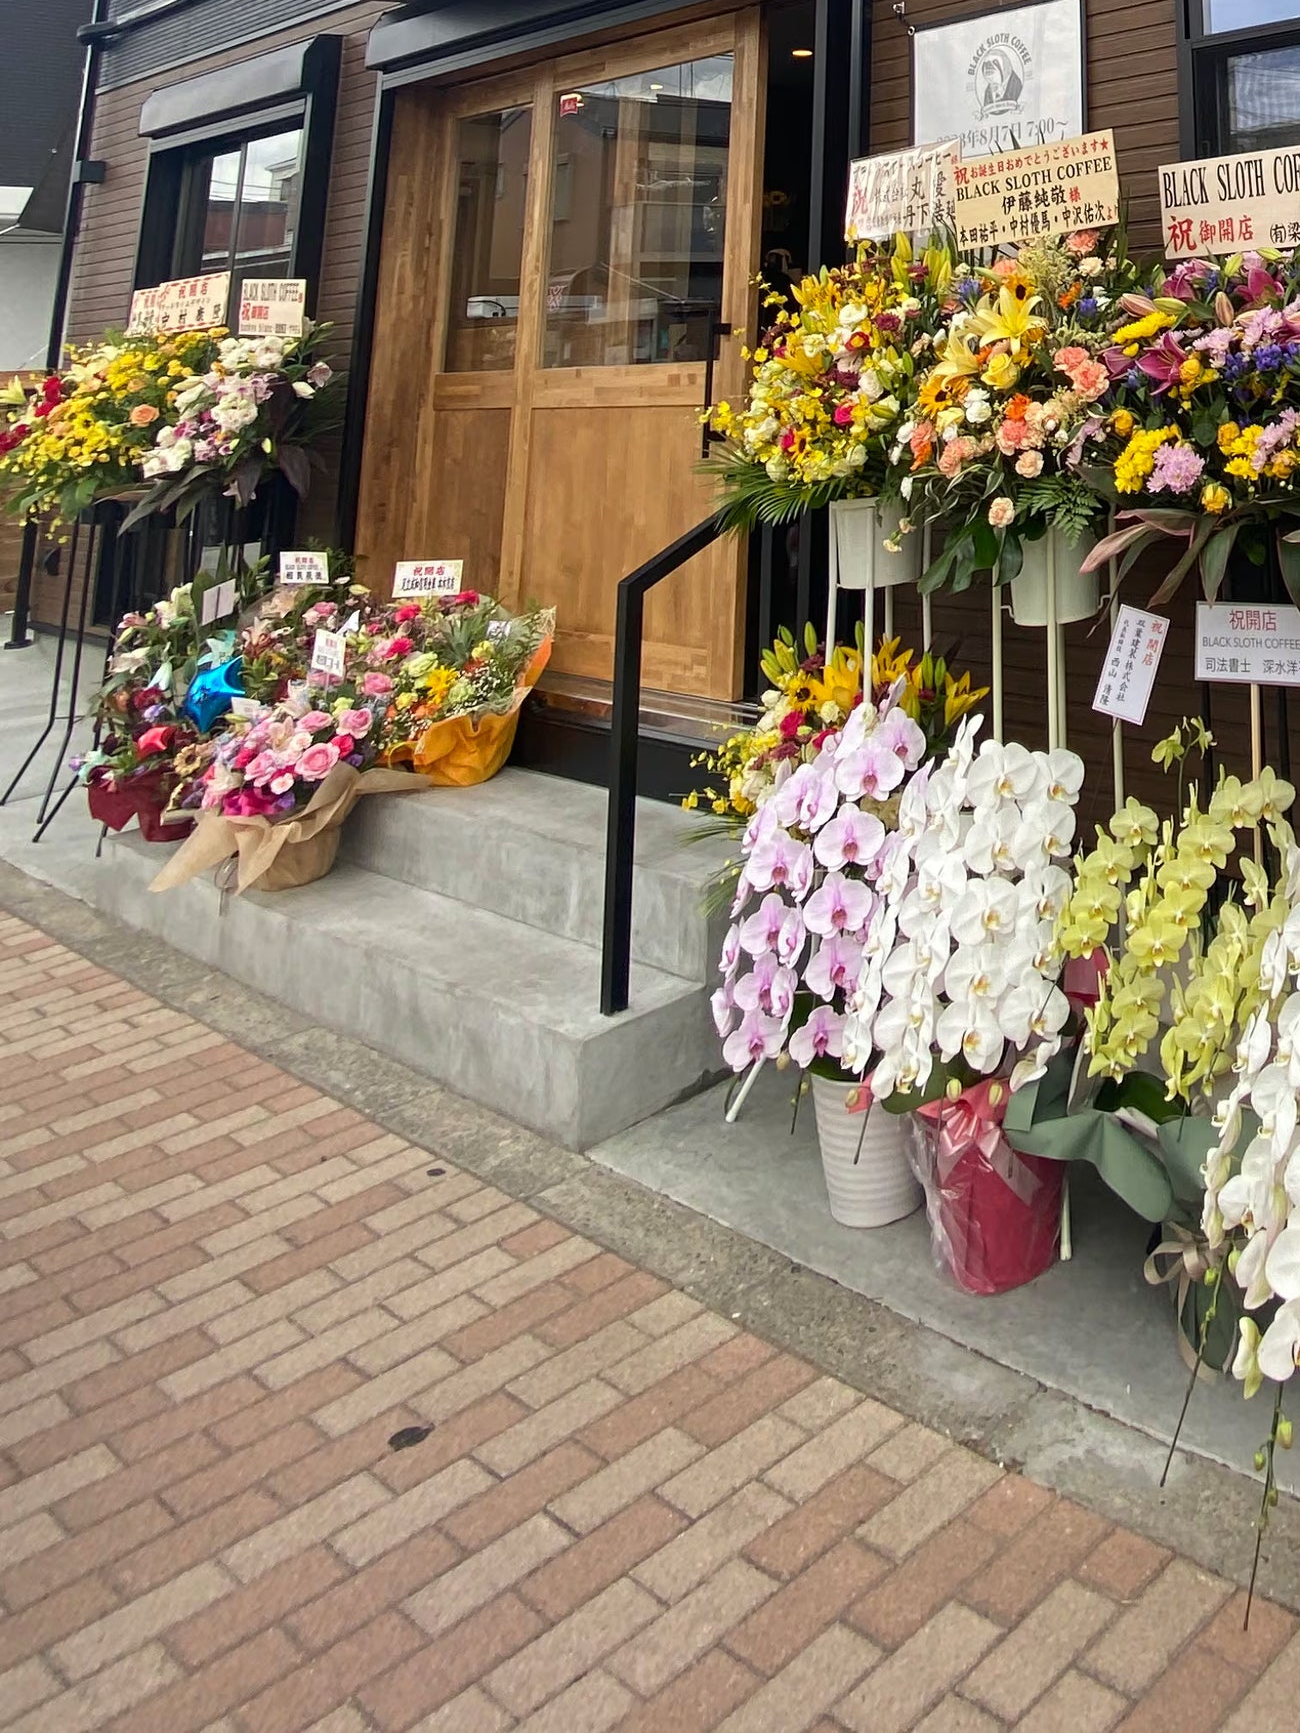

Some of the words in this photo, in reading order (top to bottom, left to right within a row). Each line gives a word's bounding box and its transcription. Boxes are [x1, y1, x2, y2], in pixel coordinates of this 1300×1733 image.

[968, 44, 987, 76] BLACK
[987, 32, 1010, 48] SLOTH
[1010, 36, 1032, 66] COFFEE
[956, 179, 1001, 202] BLACK
[1005, 168, 1052, 192] SLOTH
[1057, 156, 1113, 180] COFFEE
[1163, 167, 1209, 208] BLACK
[1217, 159, 1265, 202] SLOTH
[1229, 610, 1277, 631] 祝開店
[1202, 636, 1232, 648] BLACK
[1233, 637, 1263, 649] SLOTH
[1205, 657, 1251, 673] 司法書士
